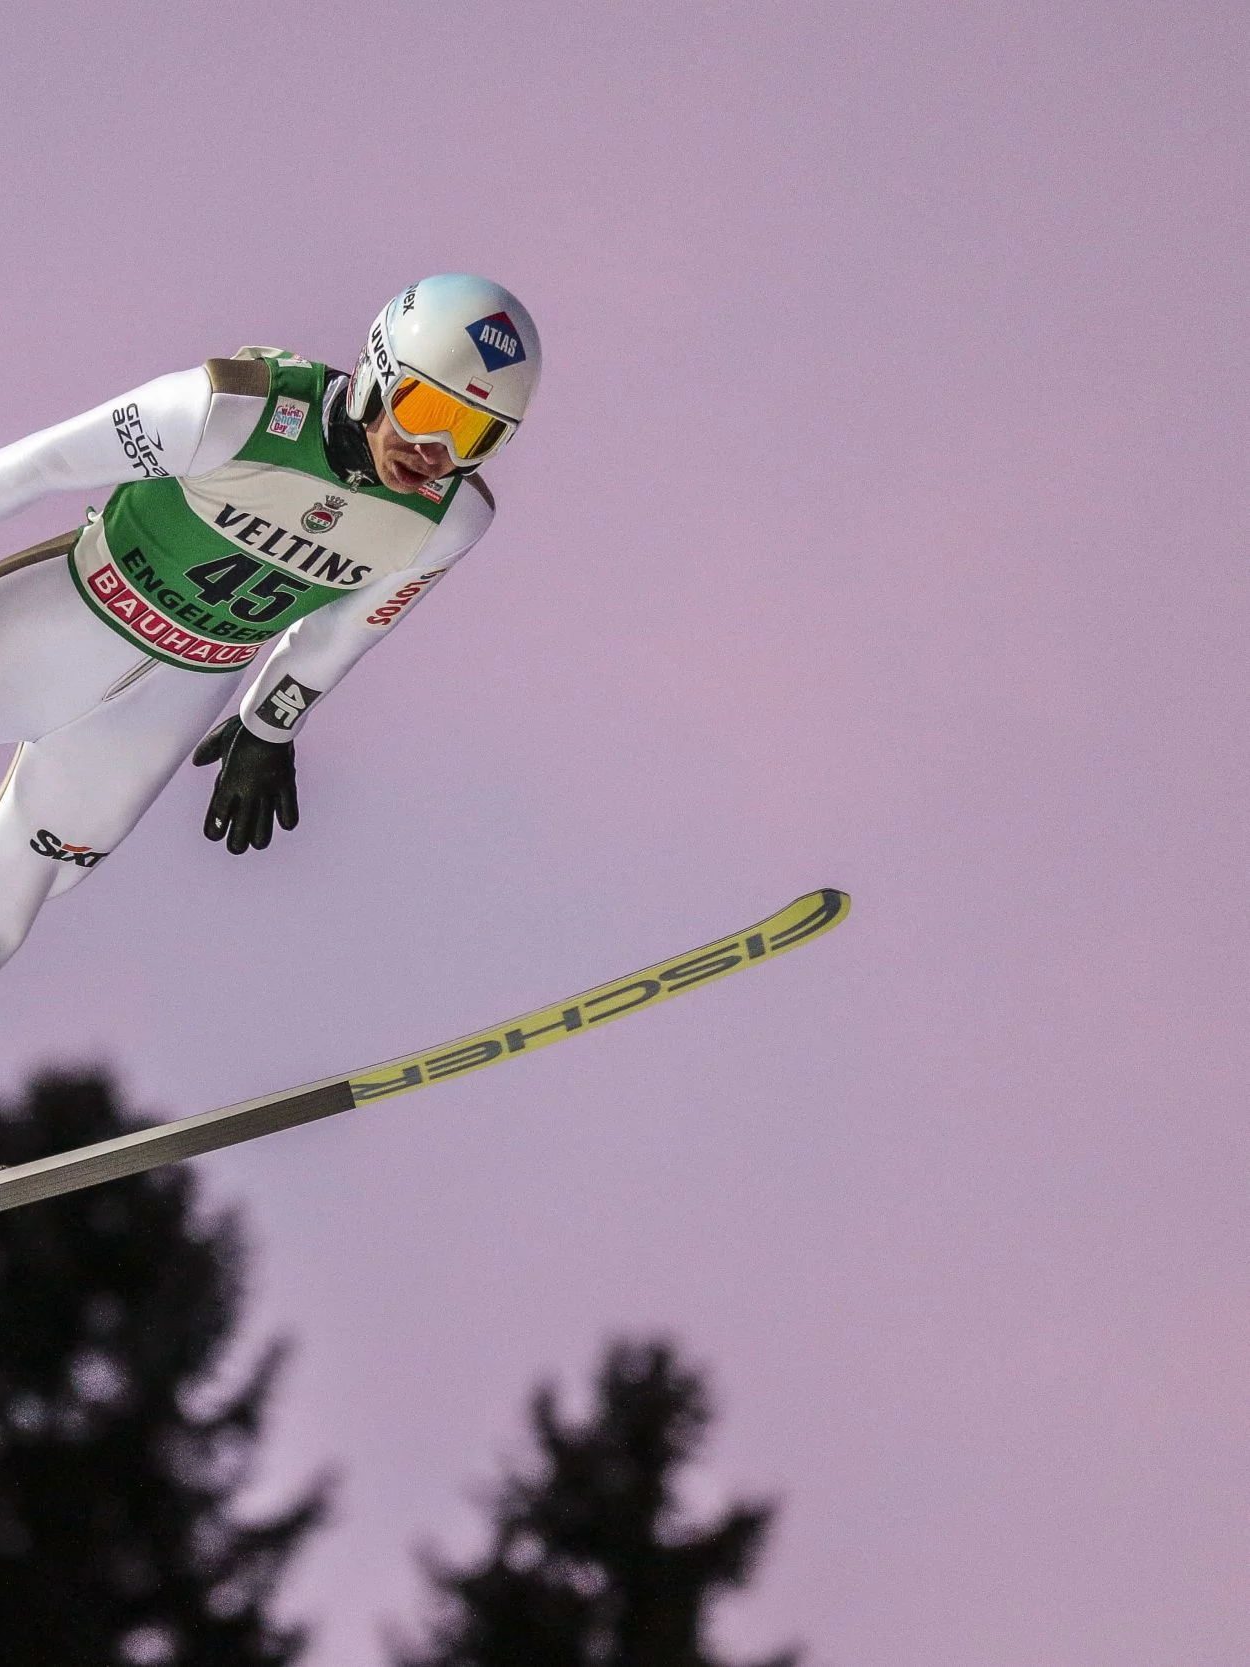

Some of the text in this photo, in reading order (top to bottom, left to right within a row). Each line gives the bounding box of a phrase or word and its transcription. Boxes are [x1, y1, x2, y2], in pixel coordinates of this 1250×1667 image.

[371, 323, 396, 387] uvex
[479, 324, 517, 358] ATLAS
[273, 422, 288, 433] Day
[214, 503, 373, 585] VELTINS
[93, 567, 259, 662] BAUHAUS
[122, 547, 276, 641] ENGELBER
[184, 552, 313, 624] 45
[366, 579, 431, 626] LOTOS
[353, 889, 842, 1101] FISCHER
